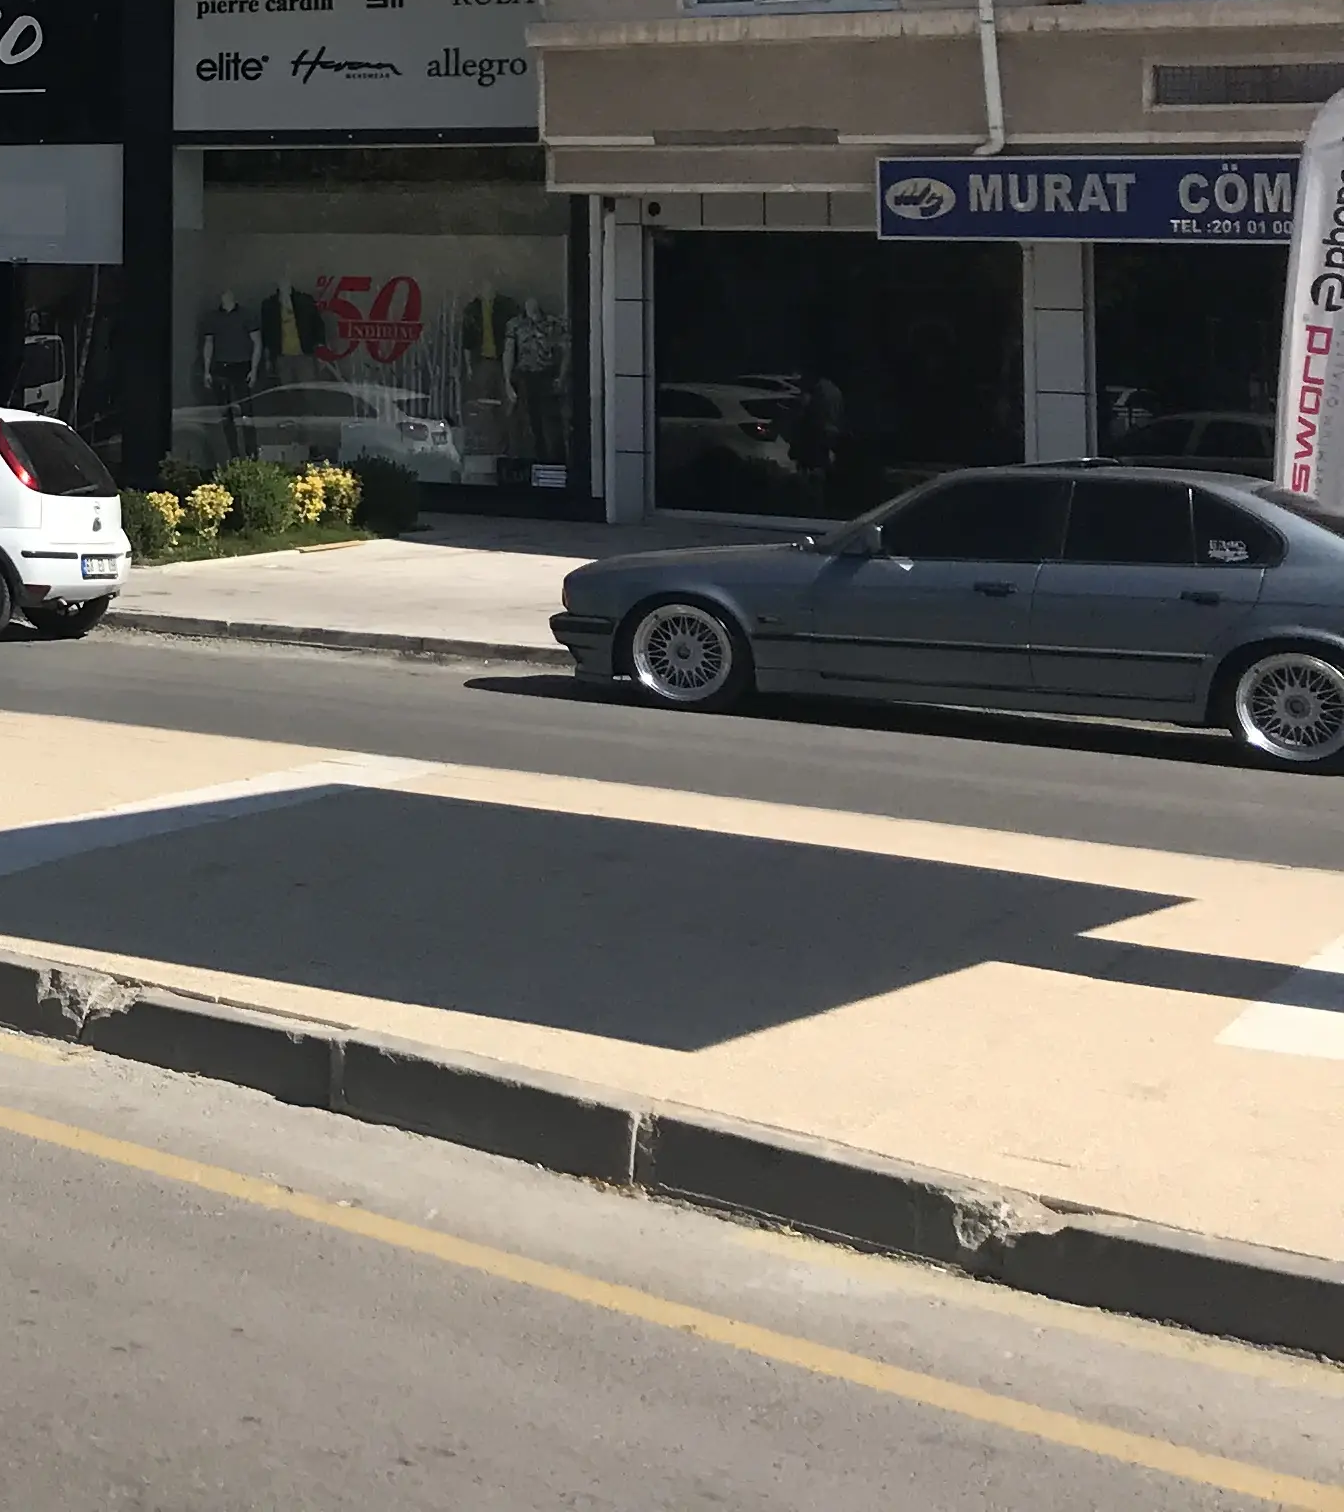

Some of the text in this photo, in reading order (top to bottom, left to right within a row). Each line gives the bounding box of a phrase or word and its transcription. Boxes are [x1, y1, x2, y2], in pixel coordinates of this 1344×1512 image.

[196, 52, 264, 81] elite
[427, 48, 527, 86] allegro
[968, 173, 1136, 213] MURAT
[1170, 219, 1202, 233] TEL
[1247, 220, 1266, 234] 01
